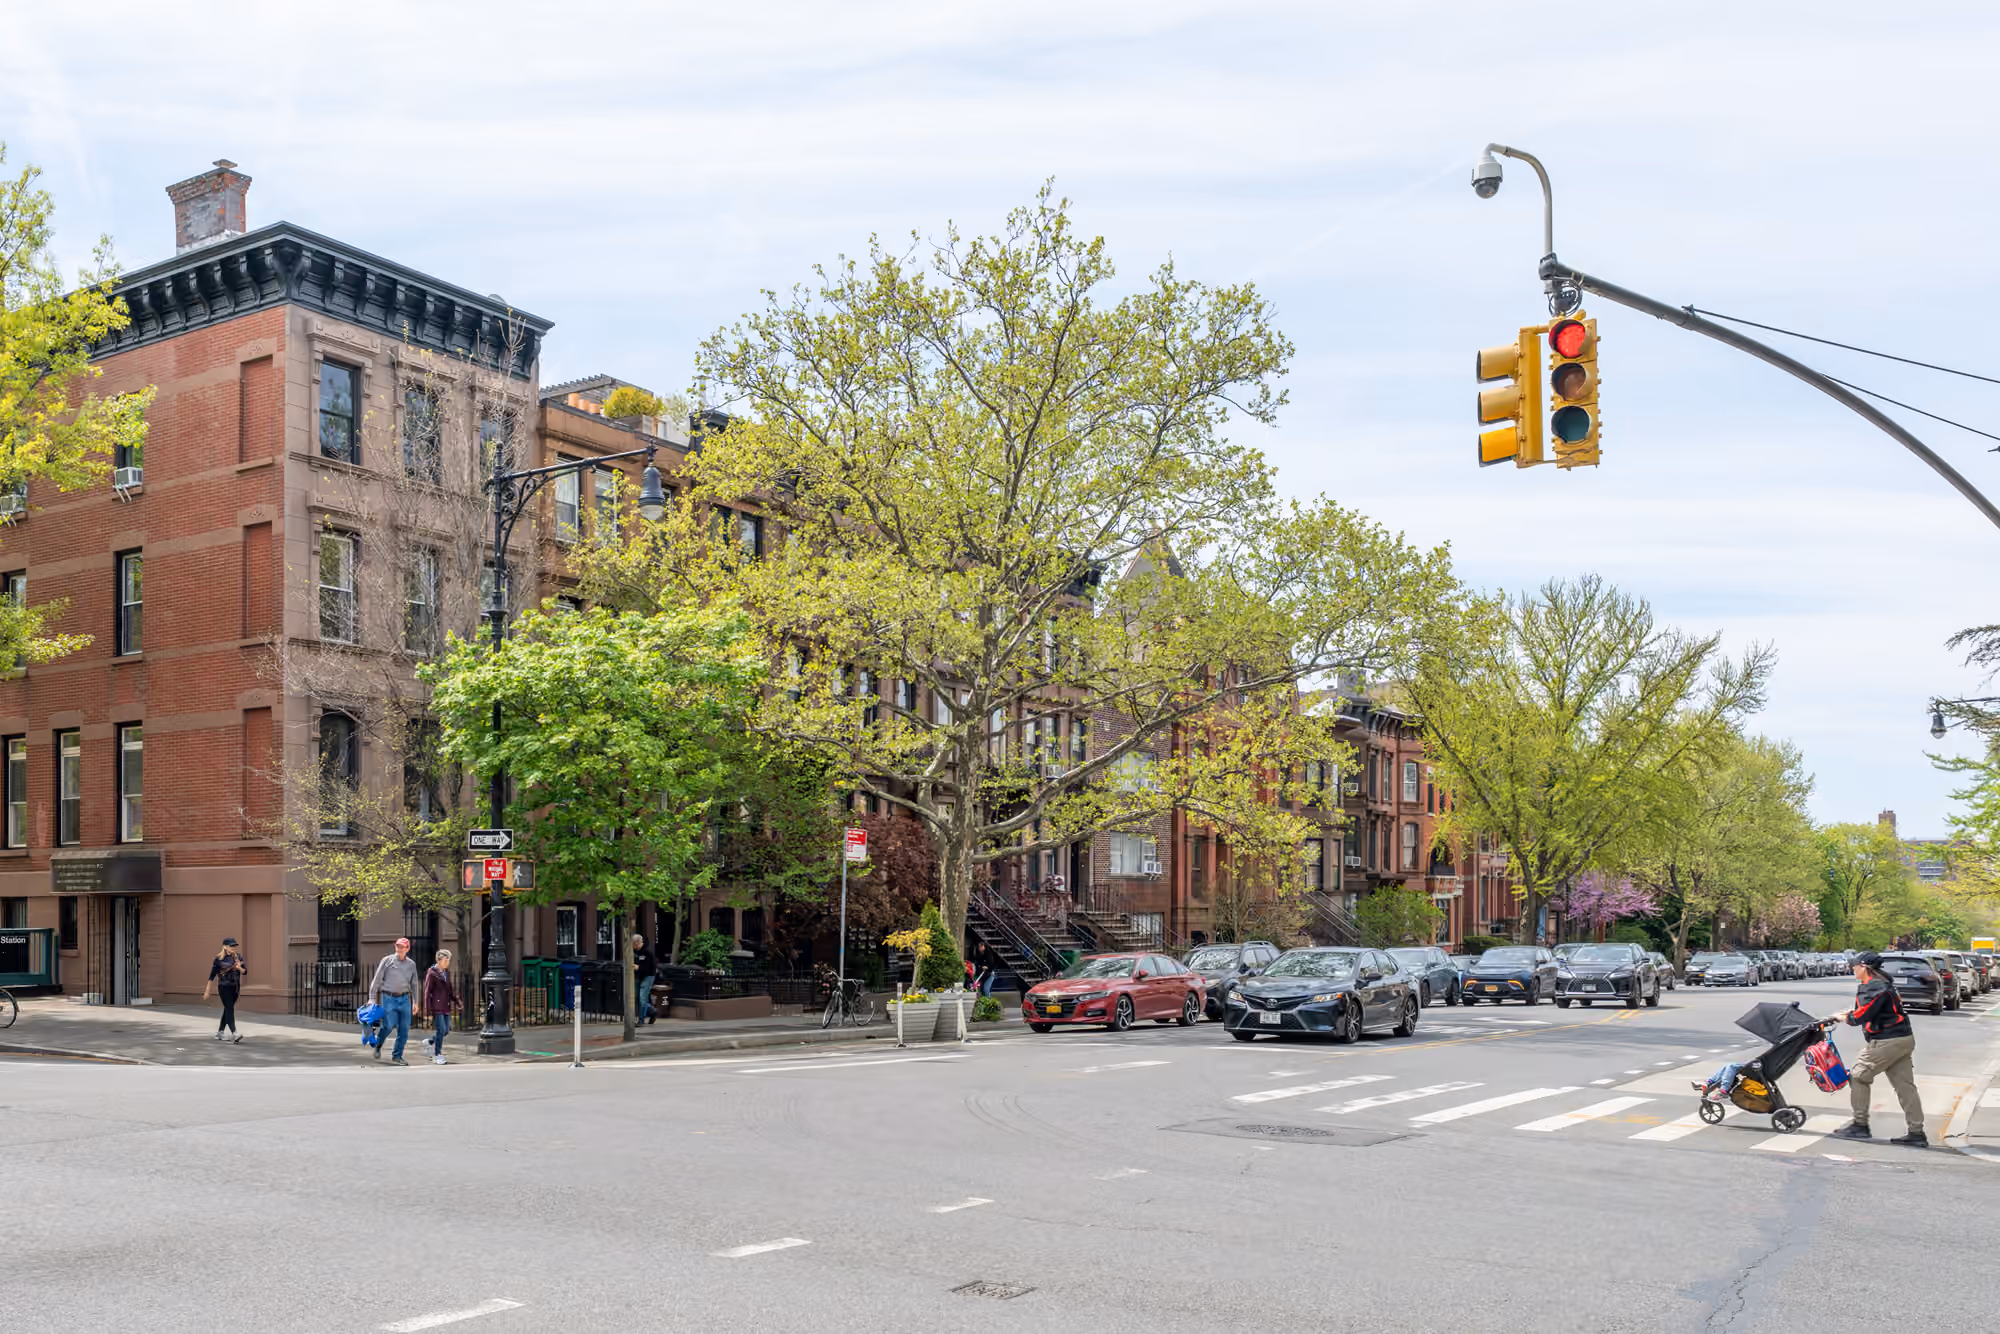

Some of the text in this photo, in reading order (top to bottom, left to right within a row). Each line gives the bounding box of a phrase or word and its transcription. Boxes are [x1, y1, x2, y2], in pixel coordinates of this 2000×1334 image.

[473, 836, 505, 845] ONE WAY
[0, 936, 26, 944] Station
